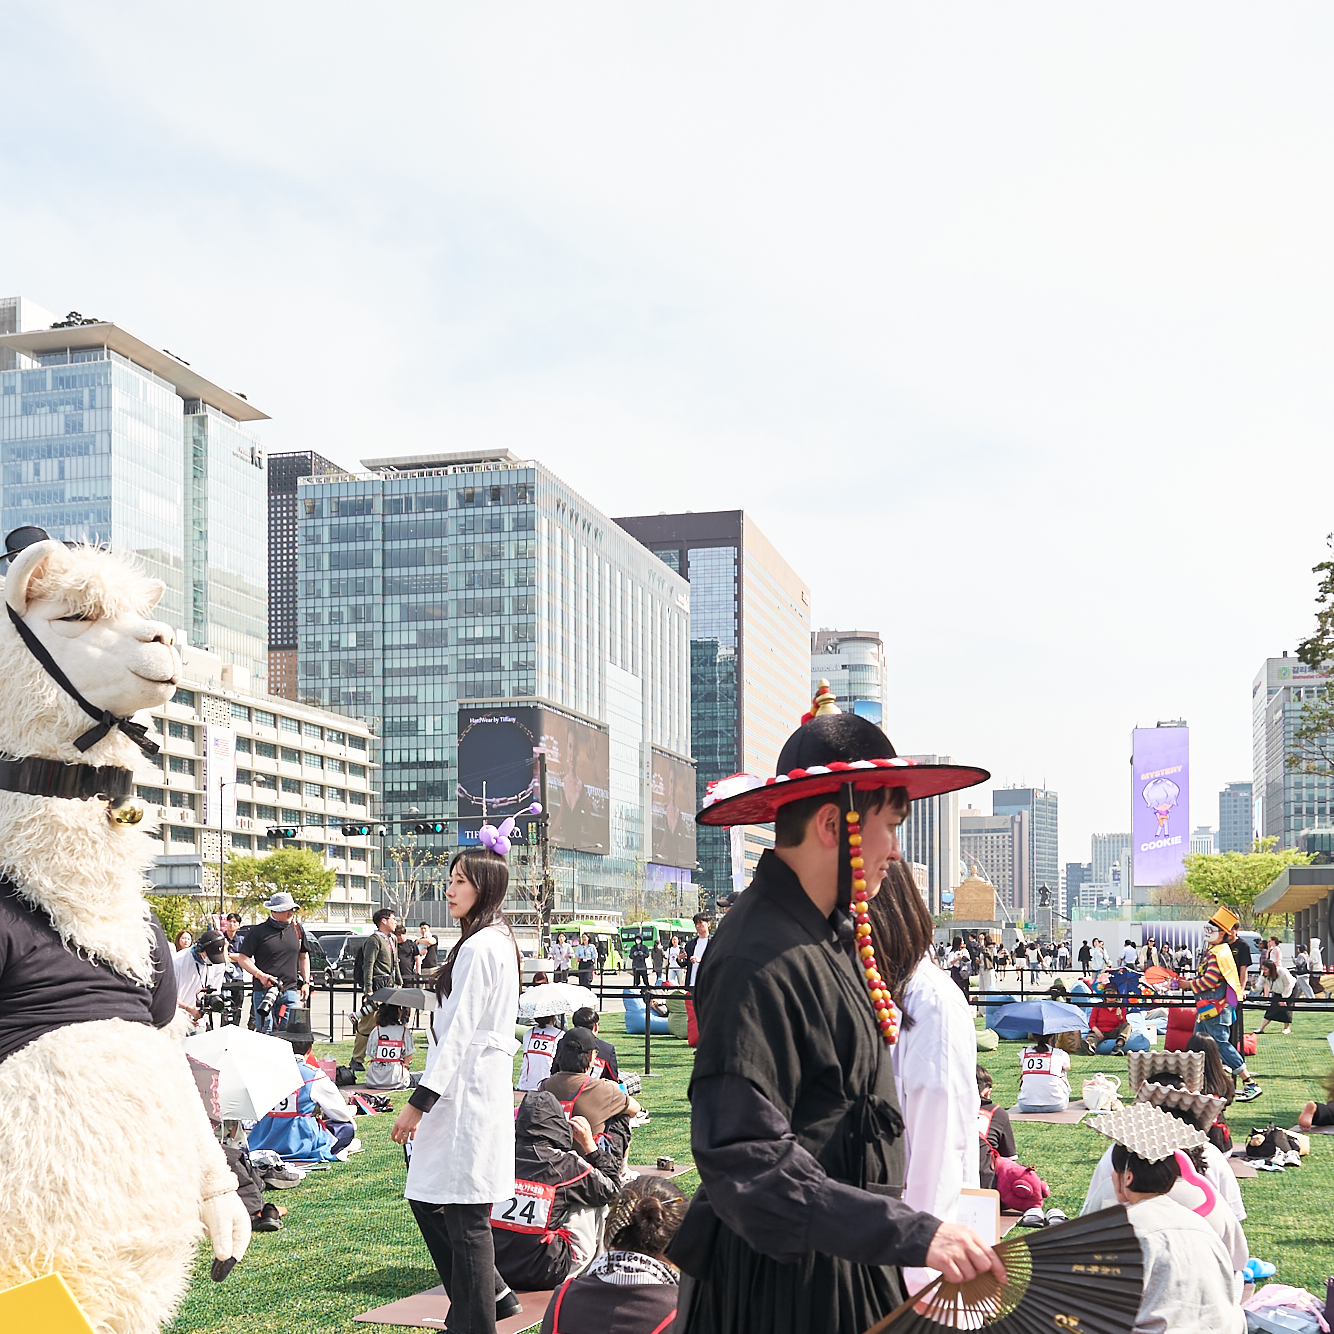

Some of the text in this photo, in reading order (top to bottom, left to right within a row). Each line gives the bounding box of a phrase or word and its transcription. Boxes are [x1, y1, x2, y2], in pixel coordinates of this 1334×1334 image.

[1141, 765, 1183, 781] MYSTERY
[1141, 835, 1182, 852] COOKIE
[533, 1039, 549, 1051] 05
[381, 1047, 396, 1058] 06
[1027, 1058, 1043, 1069] 03
[501, 1198, 536, 1224] 24
